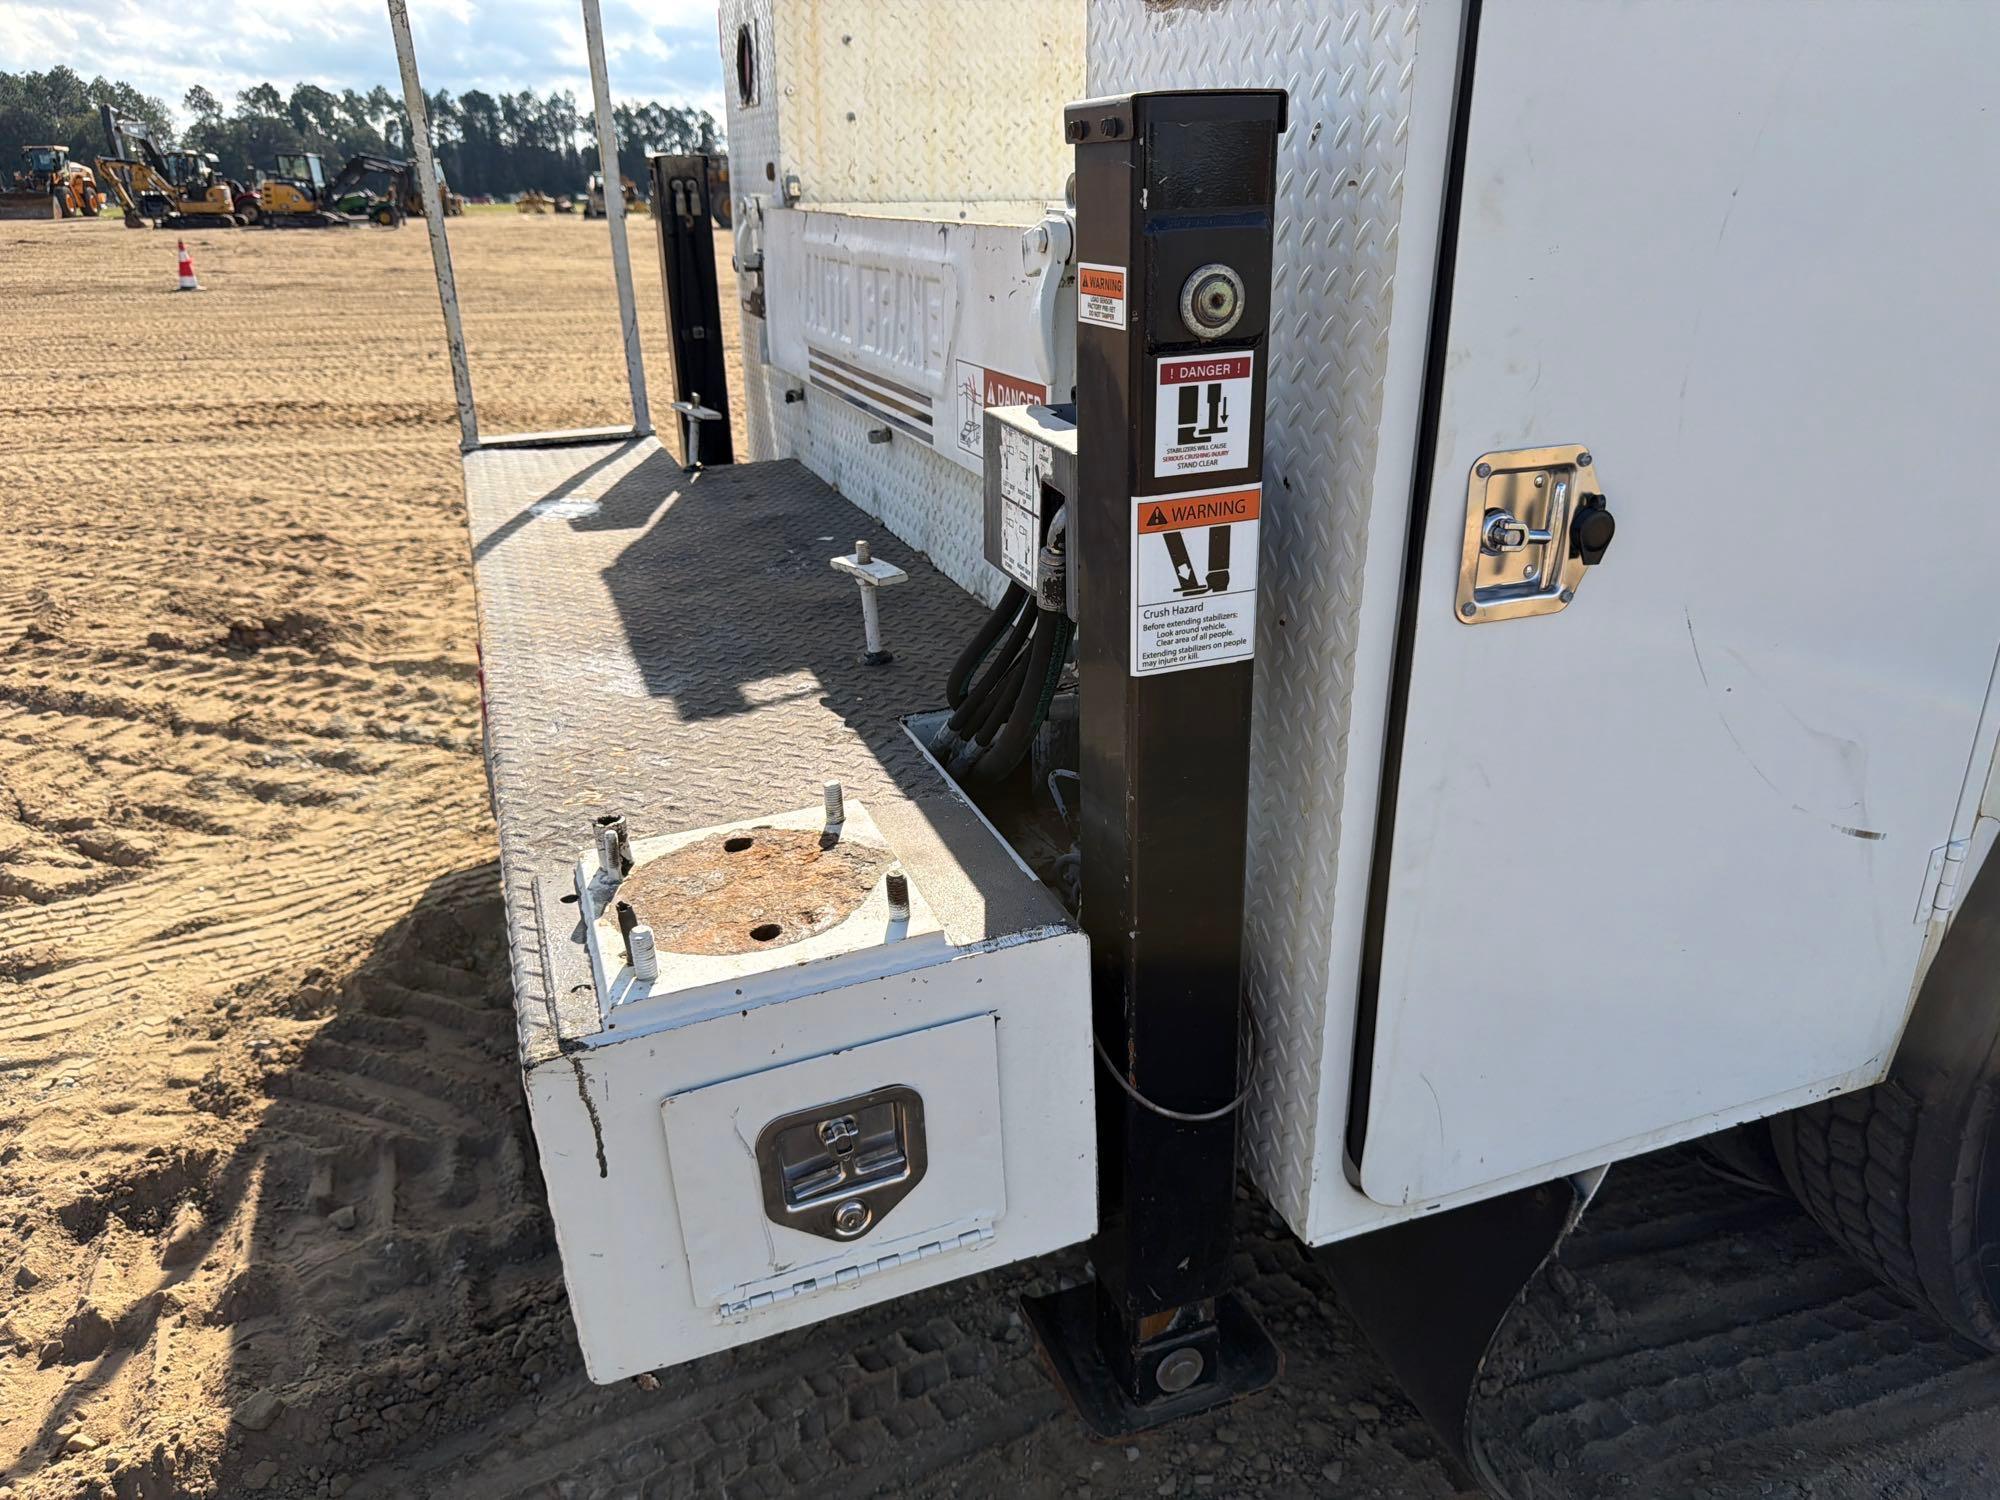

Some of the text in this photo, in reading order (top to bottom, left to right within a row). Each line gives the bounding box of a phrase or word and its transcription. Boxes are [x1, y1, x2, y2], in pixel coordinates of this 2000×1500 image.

[1090, 276, 1122, 292] WARNING
[1180, 363, 1231, 378] DANGER
[1162, 449, 1230, 462] SERIOUS CRUSHING INJURY
[1166, 445, 1197, 454] STABILIZERS
[1210, 442, 1227, 450] CAUSE
[1177, 459, 1218, 469] STAND CLEAR
[1172, 499, 1246, 522] WARNING
[1143, 602, 1204, 620] Crush Hazard
[1143, 620, 1165, 632] Before
[1167, 618, 1201, 629] extending
[1157, 622, 1226, 639] Look around vehicle.
[1156, 629, 1234, 647] Clear area of all people.
[1143, 638, 1247, 660] Extending stabilizers on people
[1142, 659, 1156, 669] may
[1158, 656, 1178, 666] injure
[1188, 651, 1200, 661] kill.
